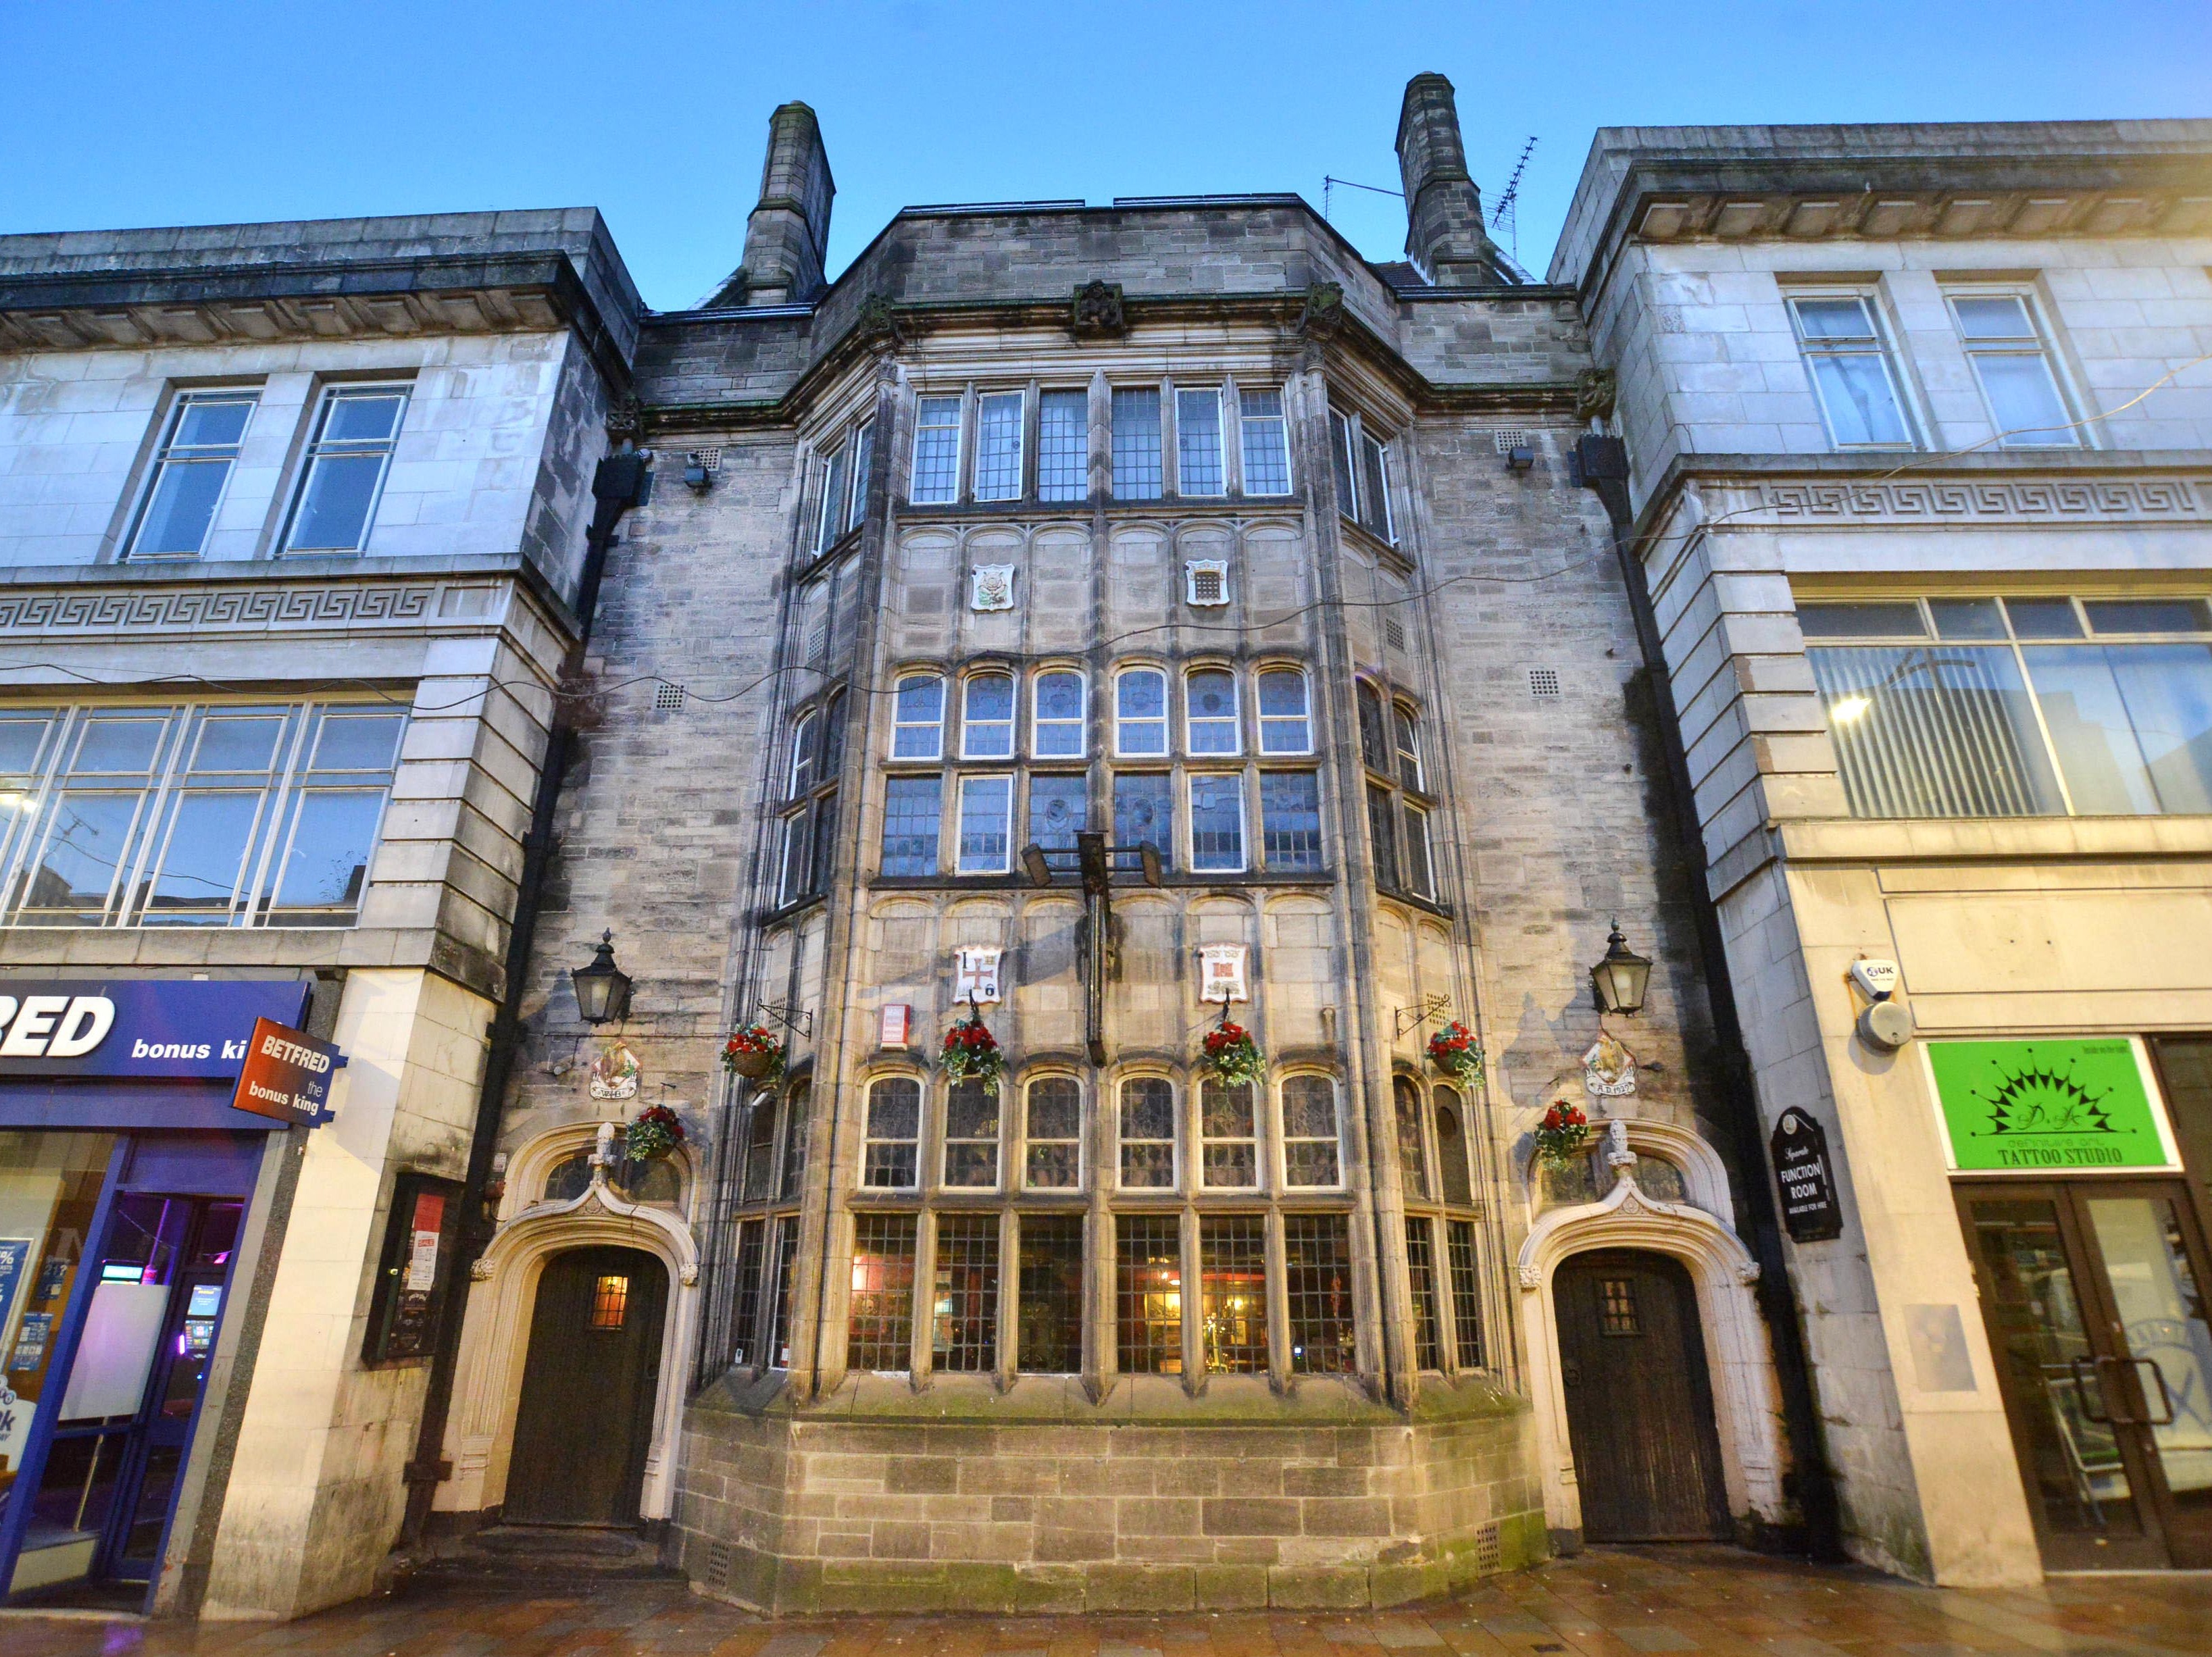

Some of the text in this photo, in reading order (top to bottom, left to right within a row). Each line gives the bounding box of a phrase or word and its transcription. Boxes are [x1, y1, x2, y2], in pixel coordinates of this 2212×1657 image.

[131, 1039, 248, 1059] bonus ki
[261, 1035, 330, 1073] BETFRED
[249, 1081, 319, 1117] bonus king
[307, 1081, 323, 1098] the
[1998, 1148, 2123, 1165] TATTOO STUDIO
[1780, 1163, 1821, 1183] FUNCTION
[1790, 1183, 1817, 1200] ROOM
[0, 1410, 16, 1431] k
